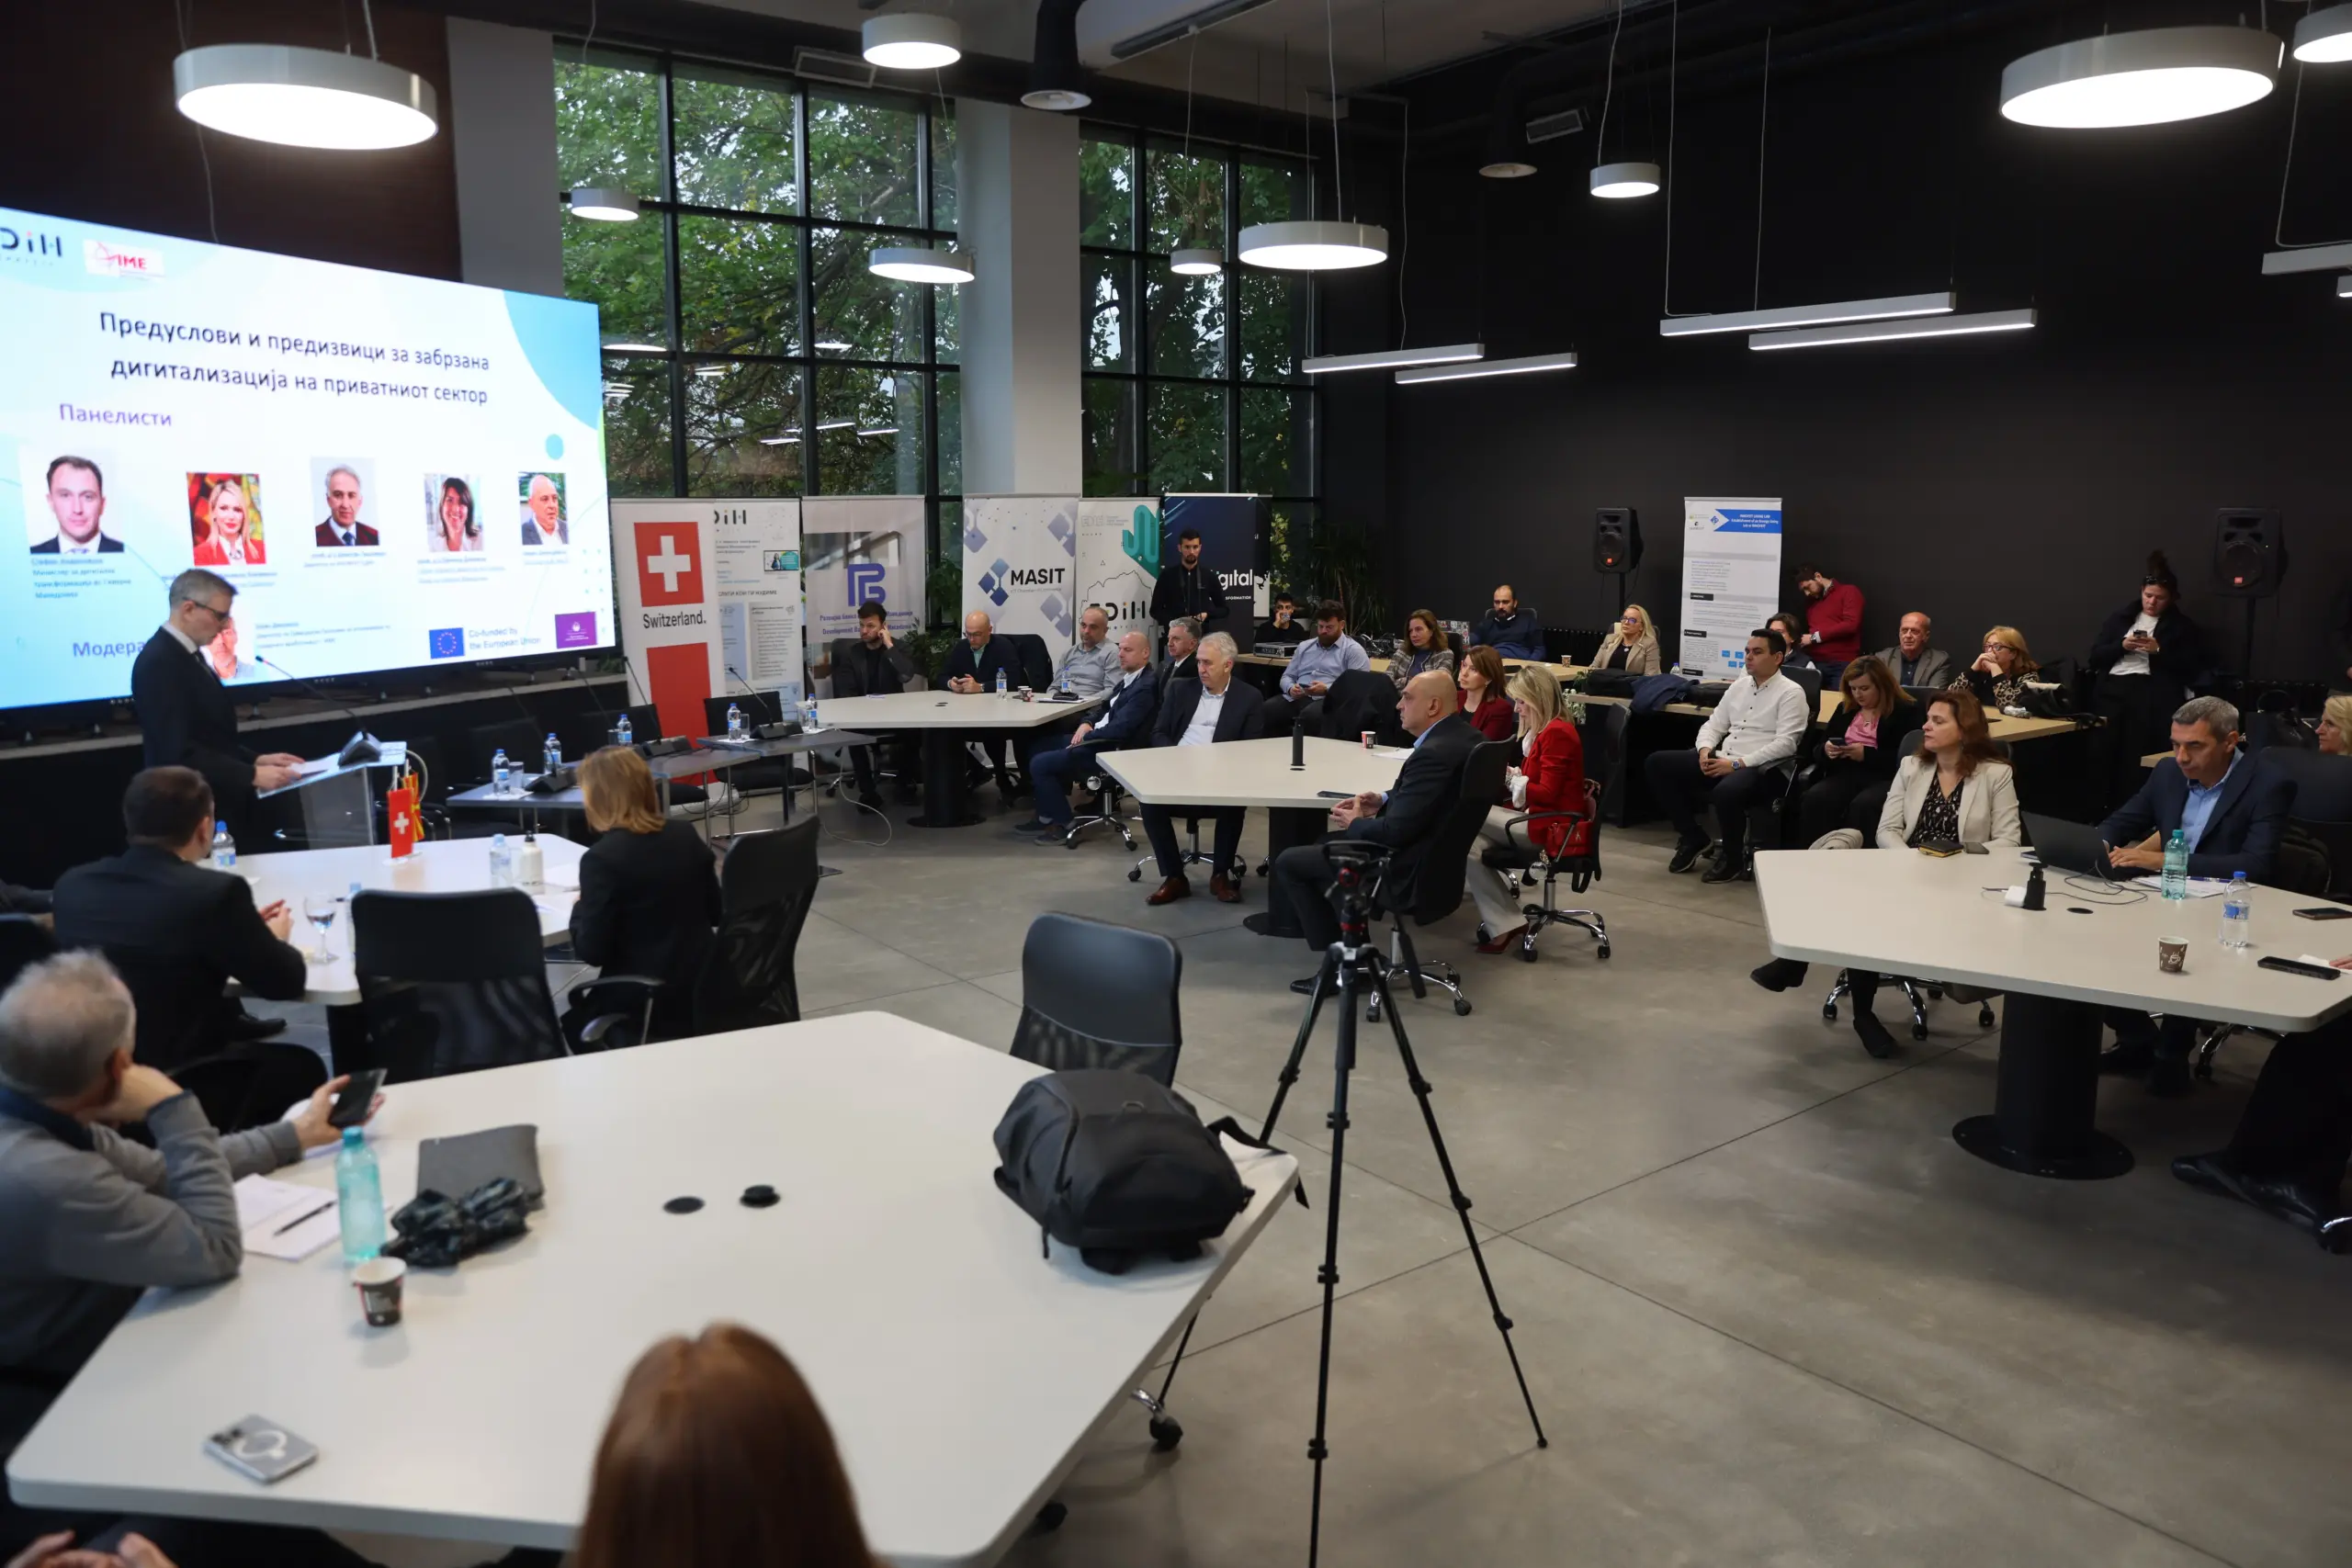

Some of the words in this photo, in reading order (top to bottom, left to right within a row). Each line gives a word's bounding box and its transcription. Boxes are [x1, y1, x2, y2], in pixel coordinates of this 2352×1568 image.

[117, 254, 147, 270] IME
[100, 311, 241, 345] Предуслови
[249, 333, 261, 347] и
[268, 334, 386, 363] предизвици
[391, 347, 410, 364] за
[414, 348, 490, 371] забрзана
[111, 359, 288, 392] дигитализација
[295, 375, 317, 391] на
[324, 378, 429, 399] приватниот
[434, 386, 489, 407] сектор
[60, 402, 172, 427] Панелисти
[1011, 568, 1066, 586] MASIT
[1216, 569, 1253, 591] gital
[643, 610, 707, 629] Switzerland.
[1090, 601, 1146, 622] DiH
